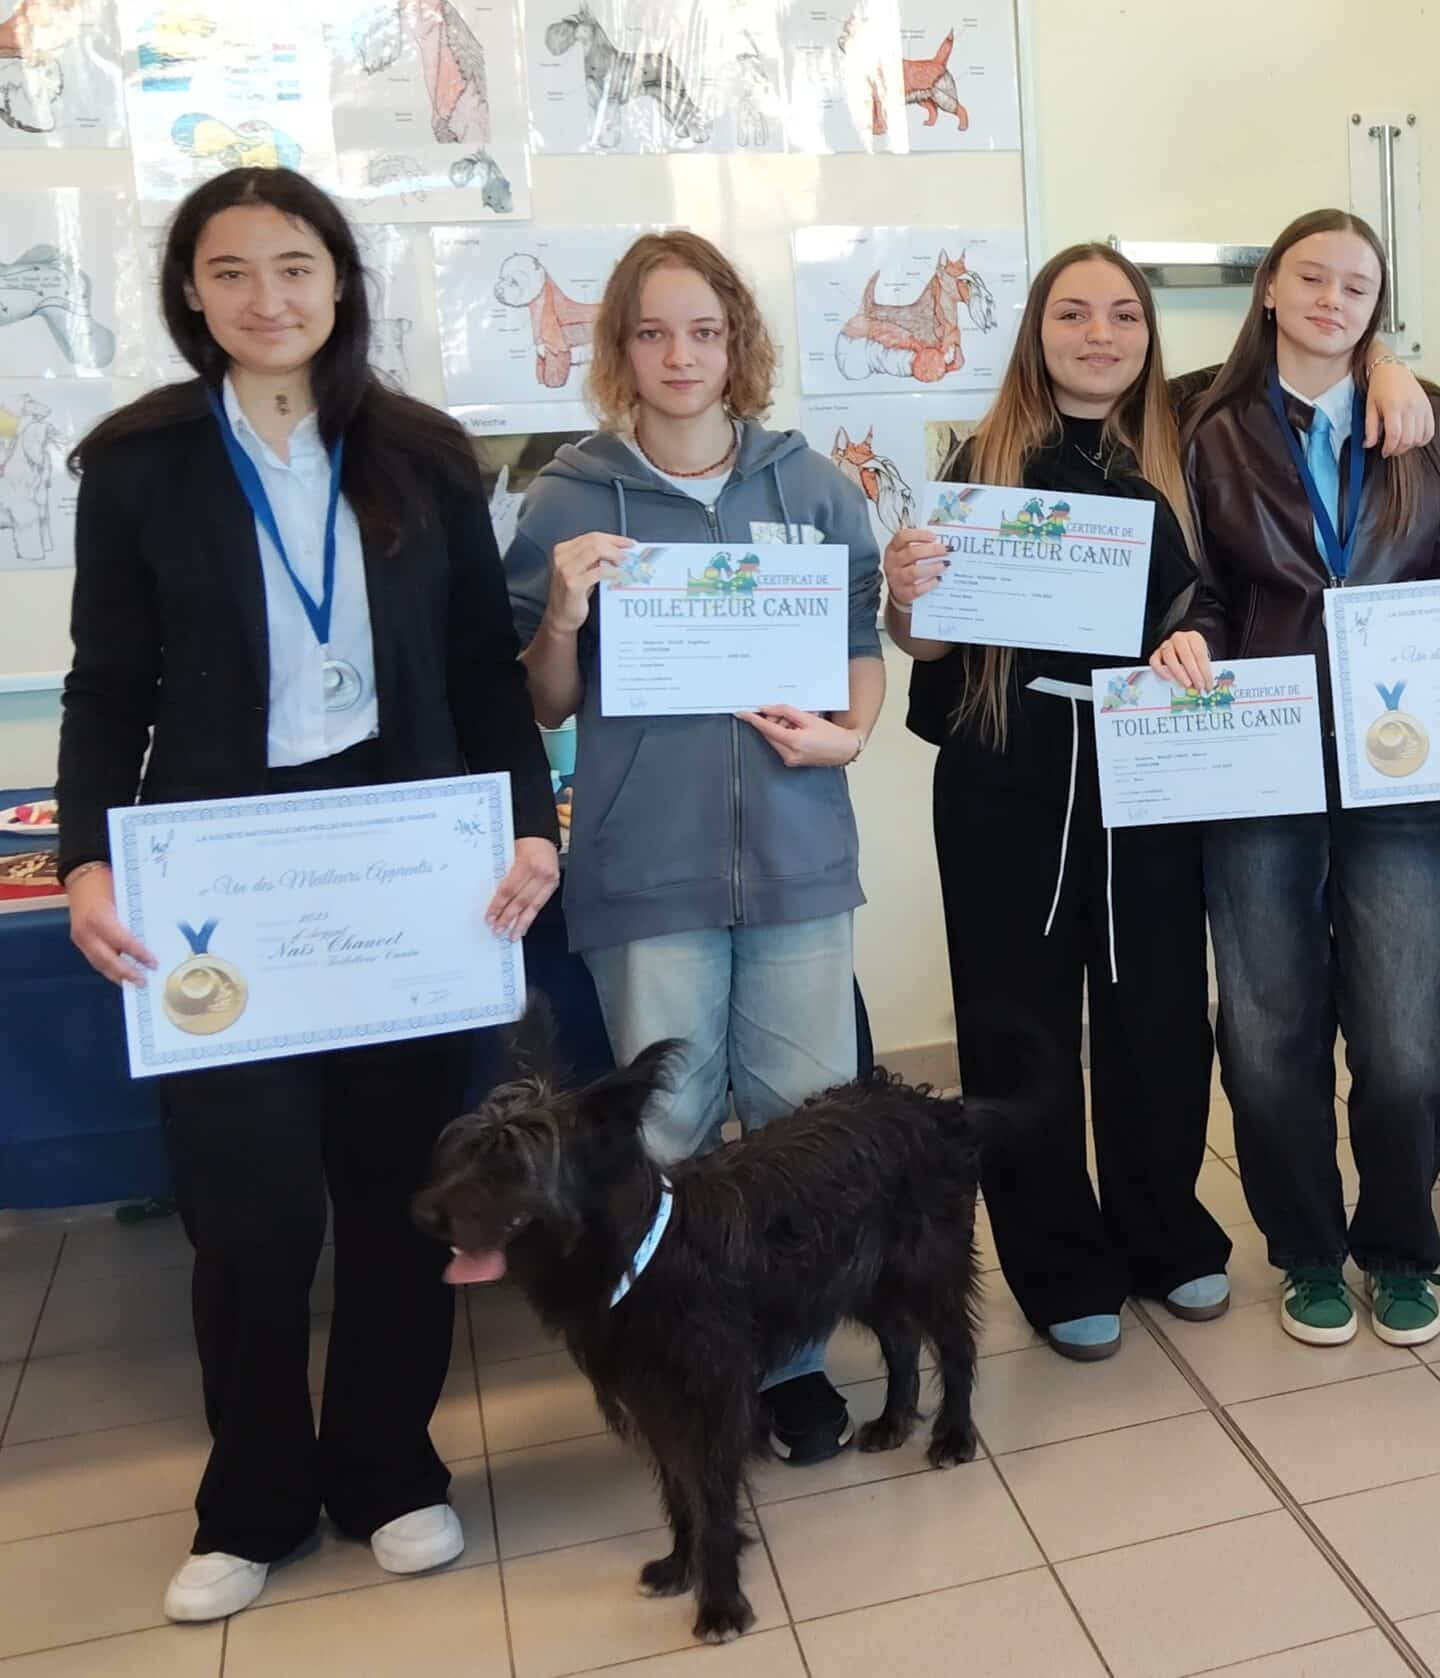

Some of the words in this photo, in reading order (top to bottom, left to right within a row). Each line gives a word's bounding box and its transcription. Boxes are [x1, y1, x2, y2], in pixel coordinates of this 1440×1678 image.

[1065, 522, 1120, 536] CERTIFICAT
[1121, 527, 1134, 538] DE
[935, 533, 1063, 562] TOILETTEUR
[1069, 544, 1134, 568] CANIN
[757, 574, 813, 585] CERTIFICAT
[815, 574, 830, 584] DE
[619, 597, 757, 618] TOILETTEUR
[763, 597, 830, 617] CANIN
[1232, 686, 1286, 699] CERTIFICAT
[1287, 684, 1301, 695] DE
[1111, 712, 1235, 738] TOILETTEUR
[1240, 706, 1303, 729] CANIN
[212, 874, 248, 897] Un
[252, 875, 276, 892] des
